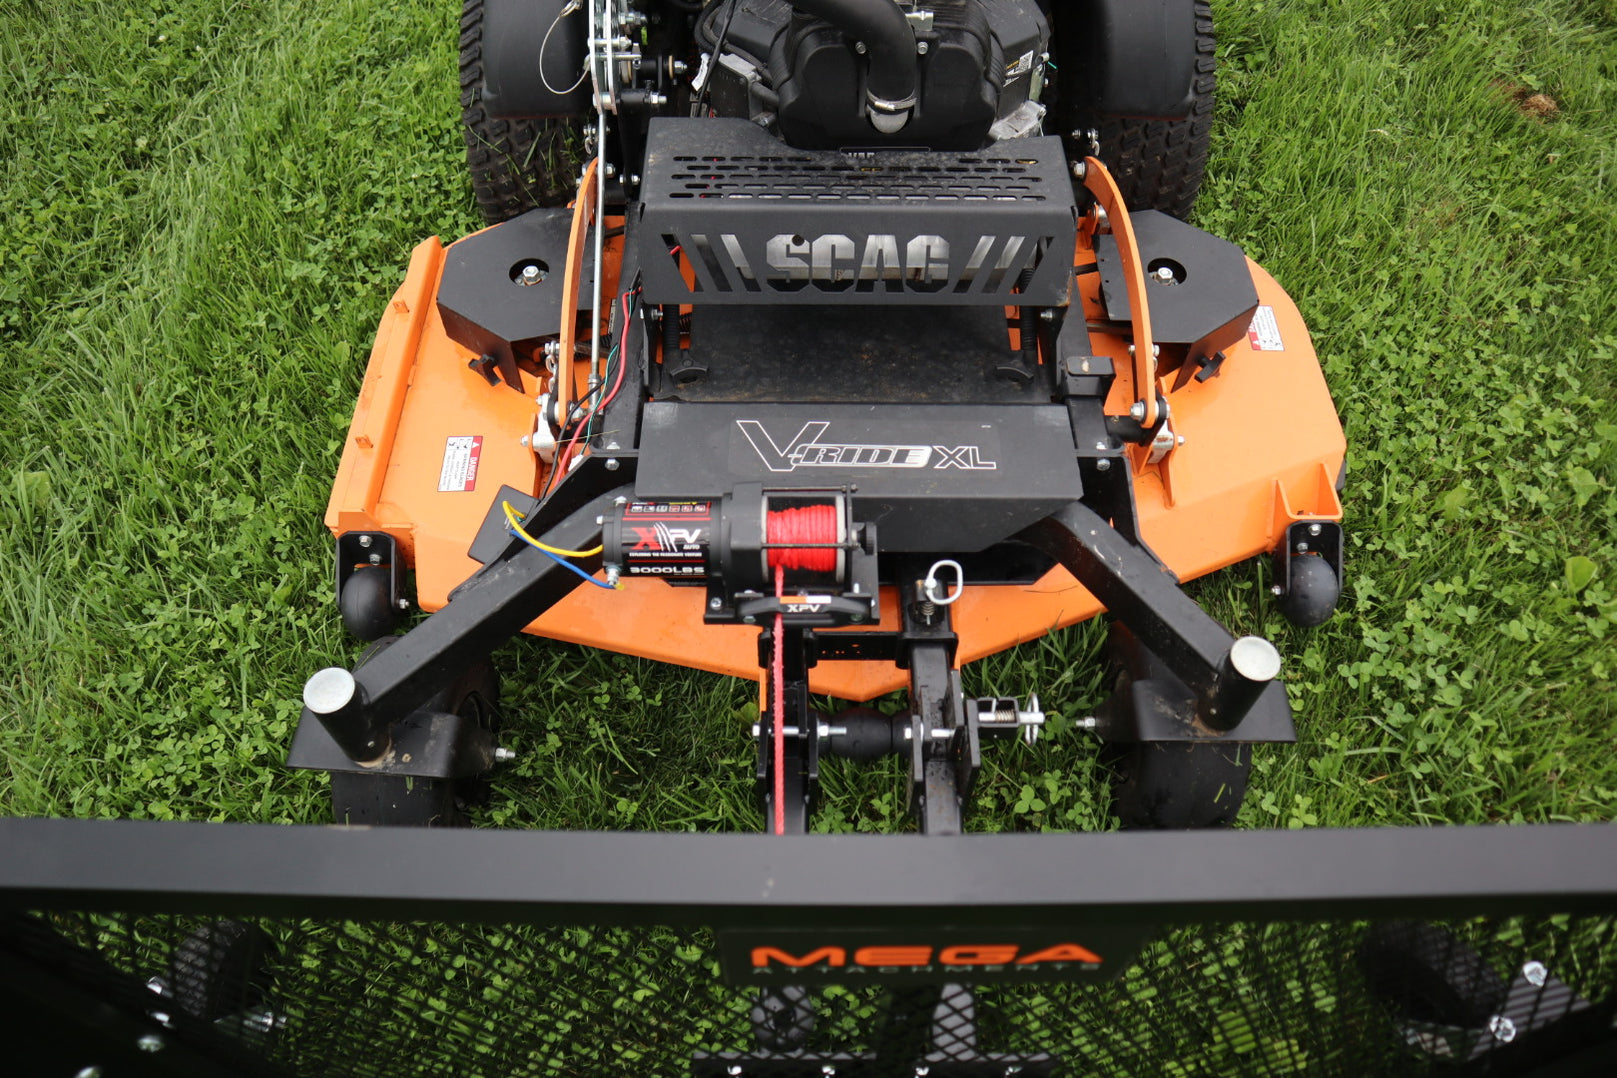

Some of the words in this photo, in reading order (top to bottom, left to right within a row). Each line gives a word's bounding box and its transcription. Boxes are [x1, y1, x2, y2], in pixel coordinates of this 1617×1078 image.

[766, 233, 950, 293] SCAG
[466, 457, 478, 480] DANGER
[932, 446, 997, 469] XL
[787, 604, 820, 613] XPV
[751, 943, 1104, 967] MEGA
